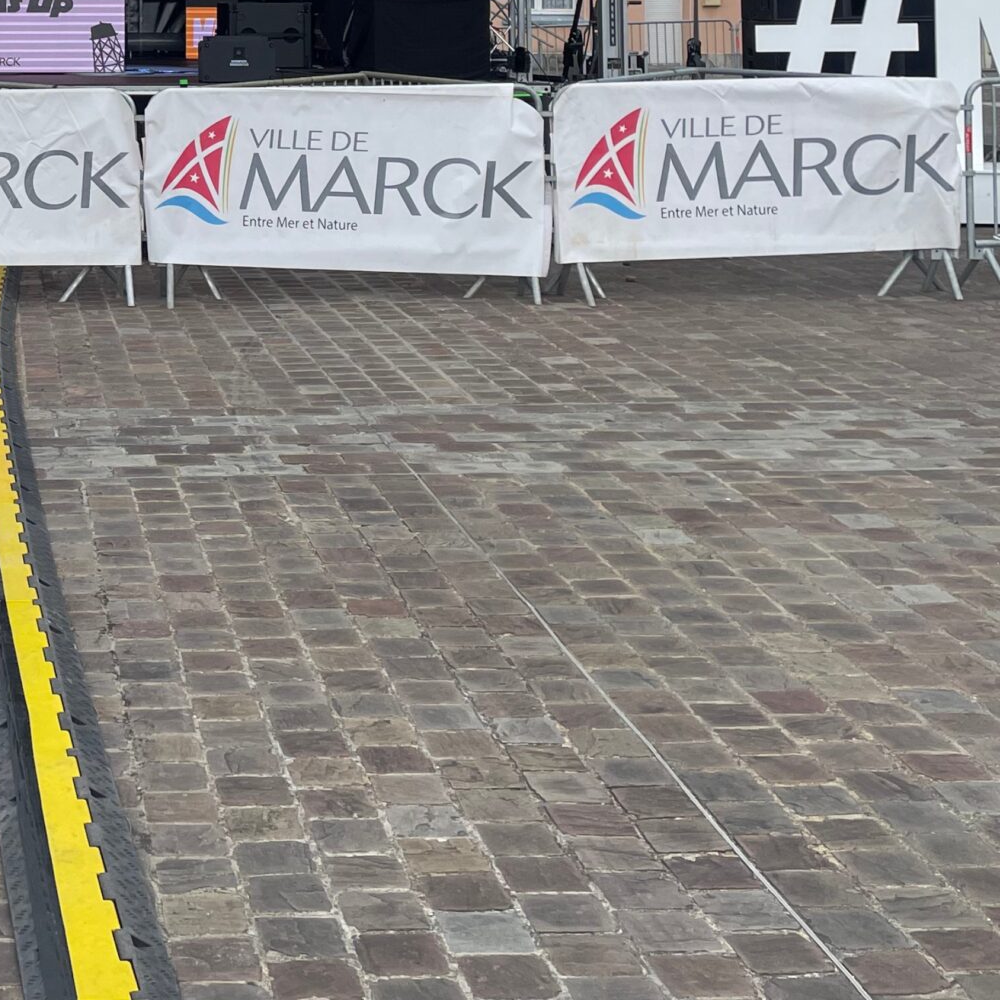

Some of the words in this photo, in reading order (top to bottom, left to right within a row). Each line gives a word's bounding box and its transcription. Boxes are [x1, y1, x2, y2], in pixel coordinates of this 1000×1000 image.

[660, 116, 736, 139] VILLE
[745, 114, 783, 135] DE
[249, 128, 323, 151] VILLE
[331, 130, 369, 152] DE
[656, 132, 956, 202] MARCK
[239, 152, 533, 219] MARCK
[242, 215, 274, 228] Entre
[276, 216, 300, 229] Mer
[302, 218, 314, 230] et
[317, 217, 359, 231] Nature
[660, 207, 692, 219] Entre
[695, 205, 719, 218] Mer
[721, 206, 734, 217] et
[736, 204, 778, 217] Nature
